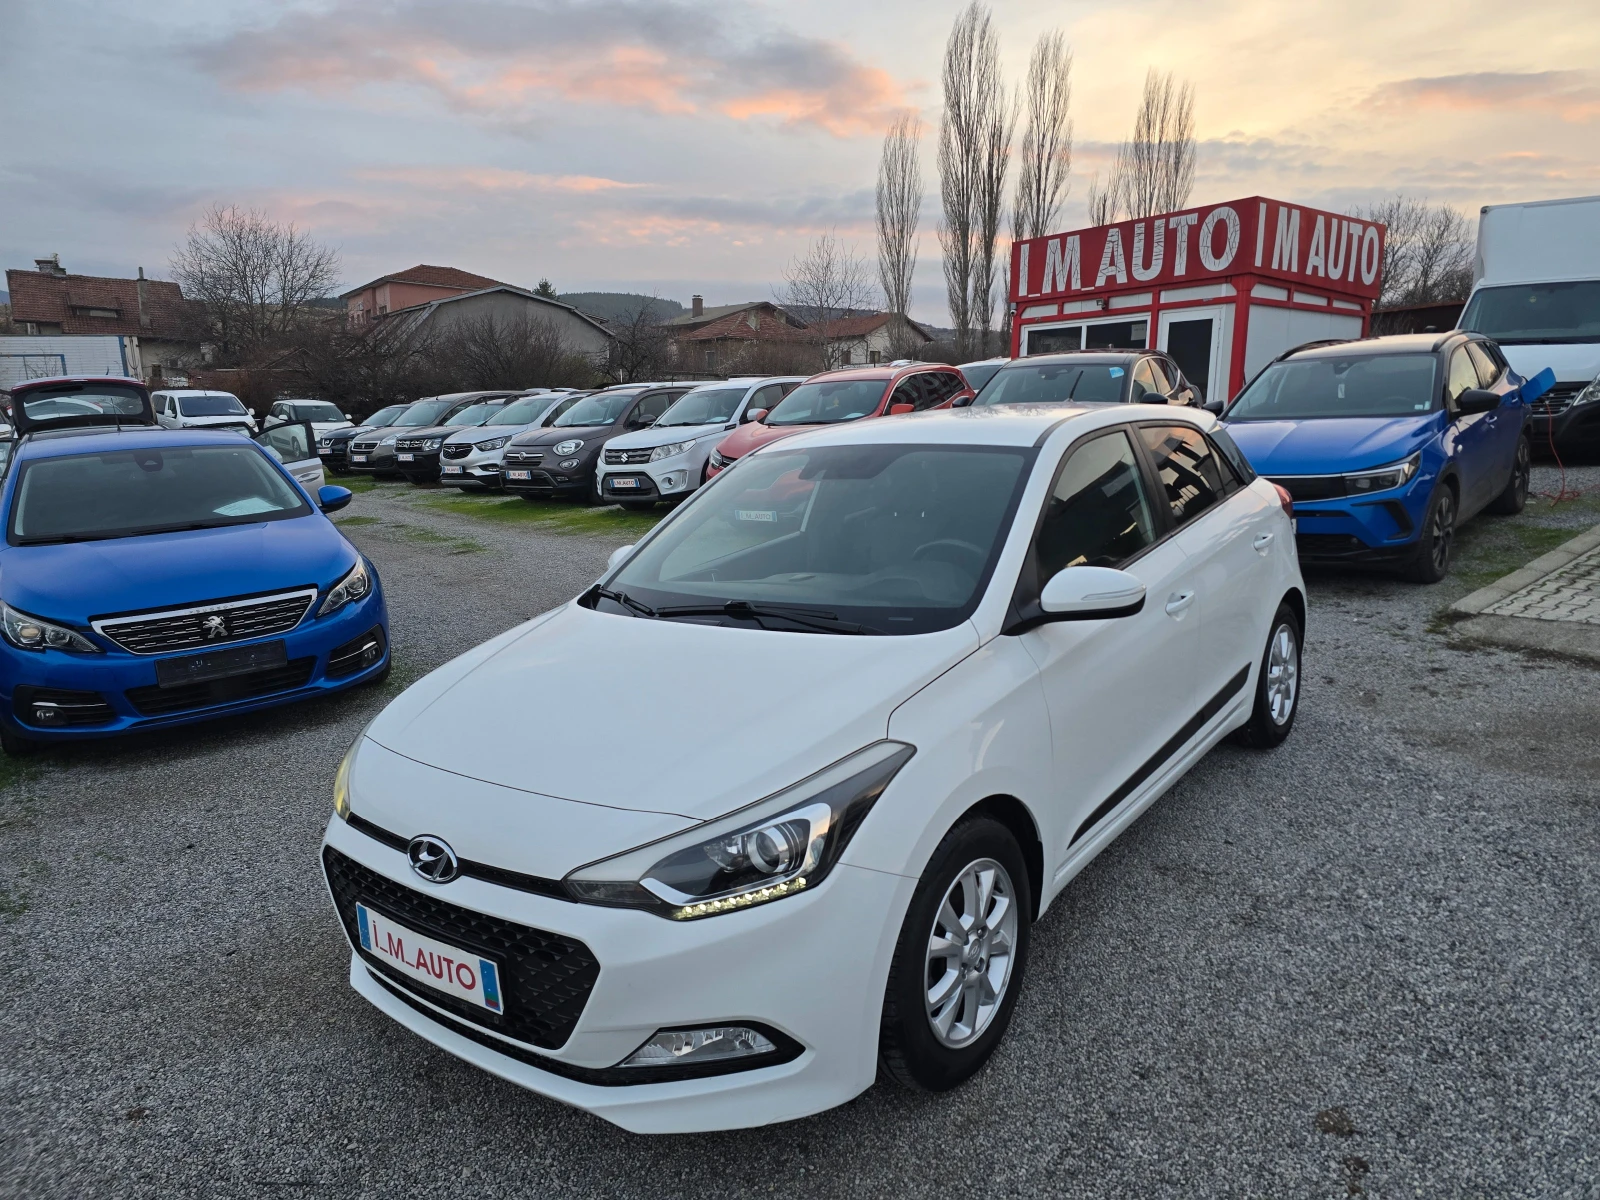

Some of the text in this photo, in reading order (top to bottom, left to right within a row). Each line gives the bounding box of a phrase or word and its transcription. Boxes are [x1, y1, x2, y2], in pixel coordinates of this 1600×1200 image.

[1254, 202, 1379, 286] I M AUTO
